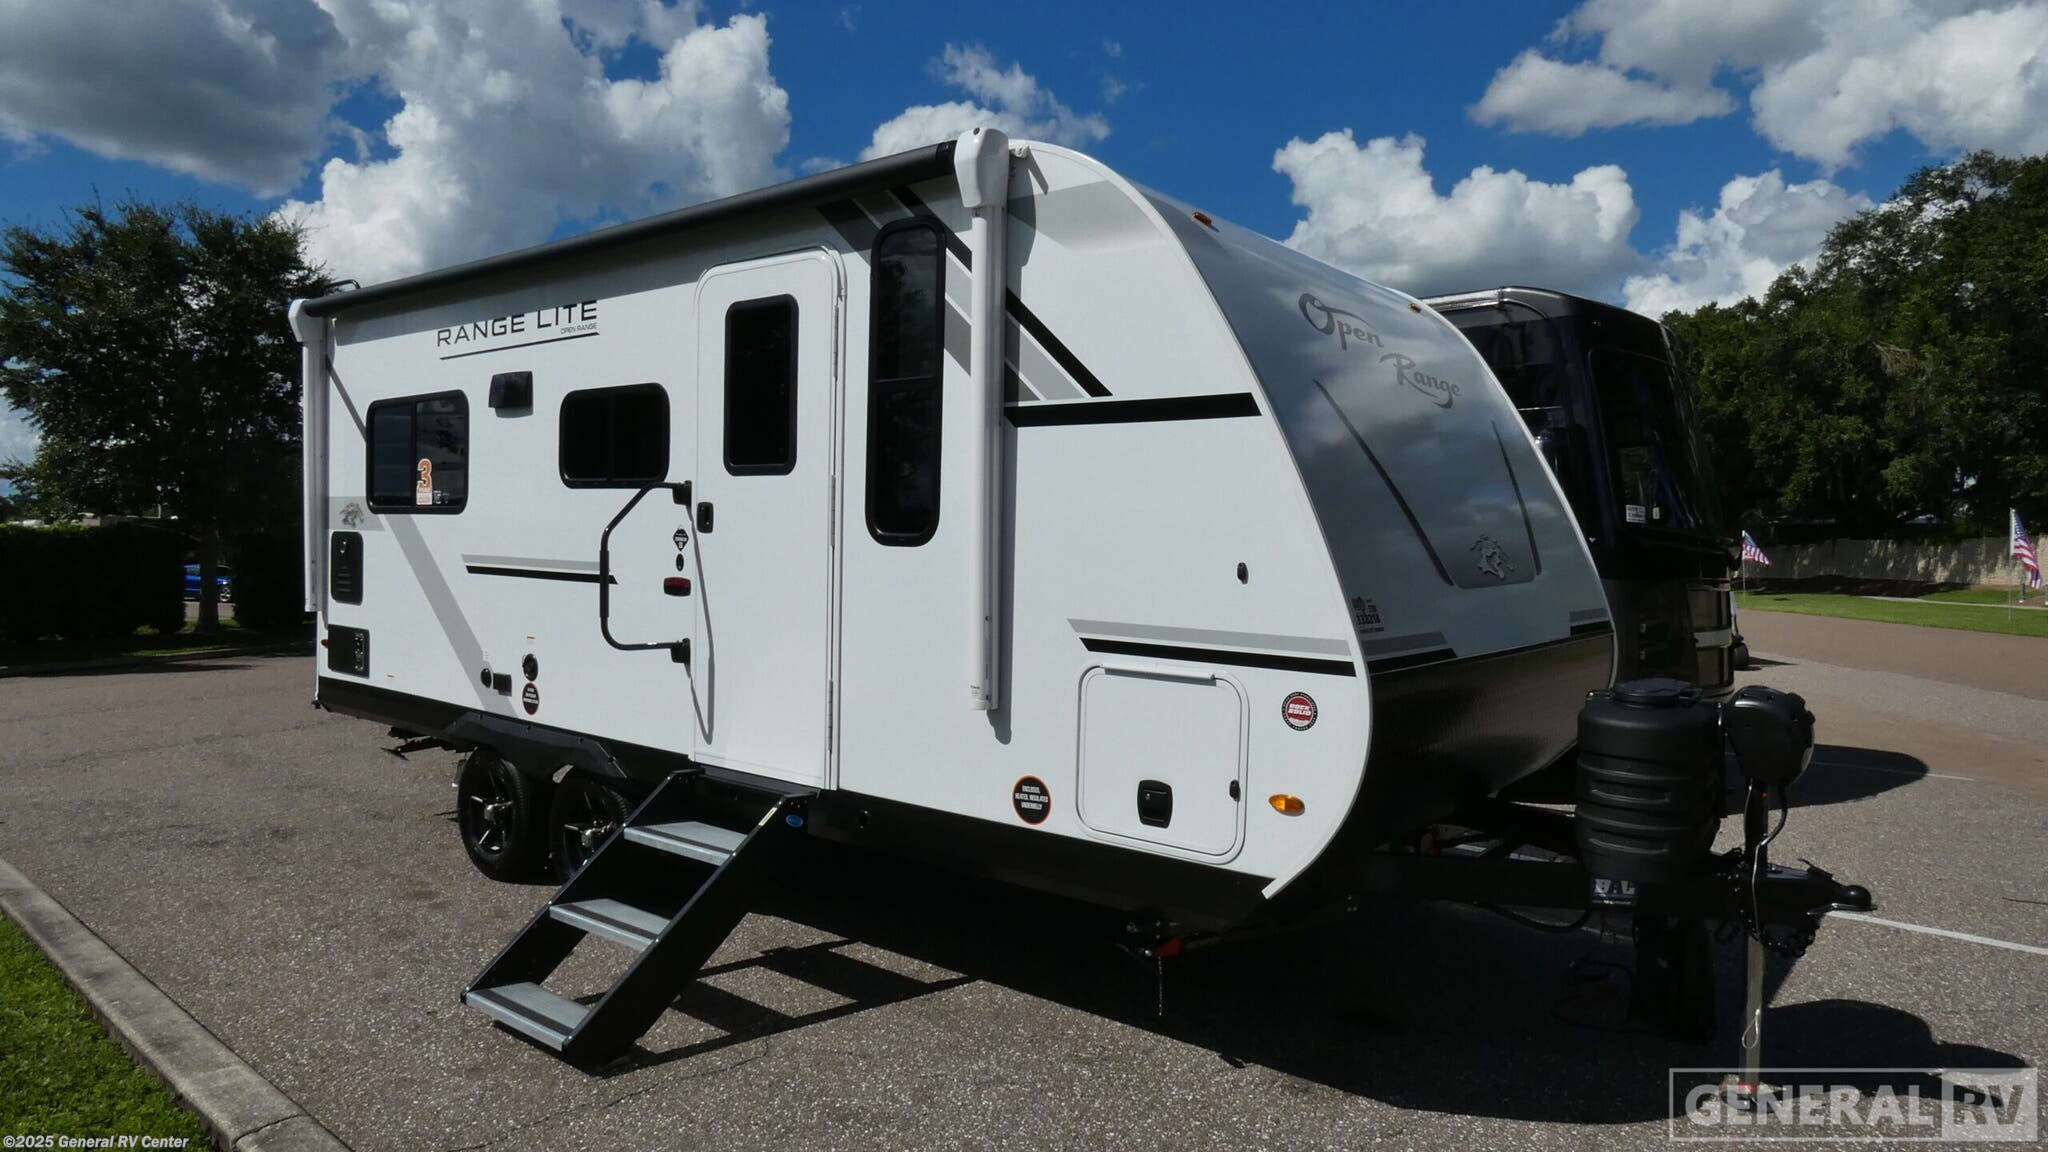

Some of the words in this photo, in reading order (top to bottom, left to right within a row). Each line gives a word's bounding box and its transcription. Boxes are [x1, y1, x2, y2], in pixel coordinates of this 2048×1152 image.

[437, 314, 525, 347] RANGE
[537, 300, 598, 329] LITE
[1298, 292, 1385, 351] Open
[1379, 352, 1463, 409] Range
[417, 458, 432, 489] 3
